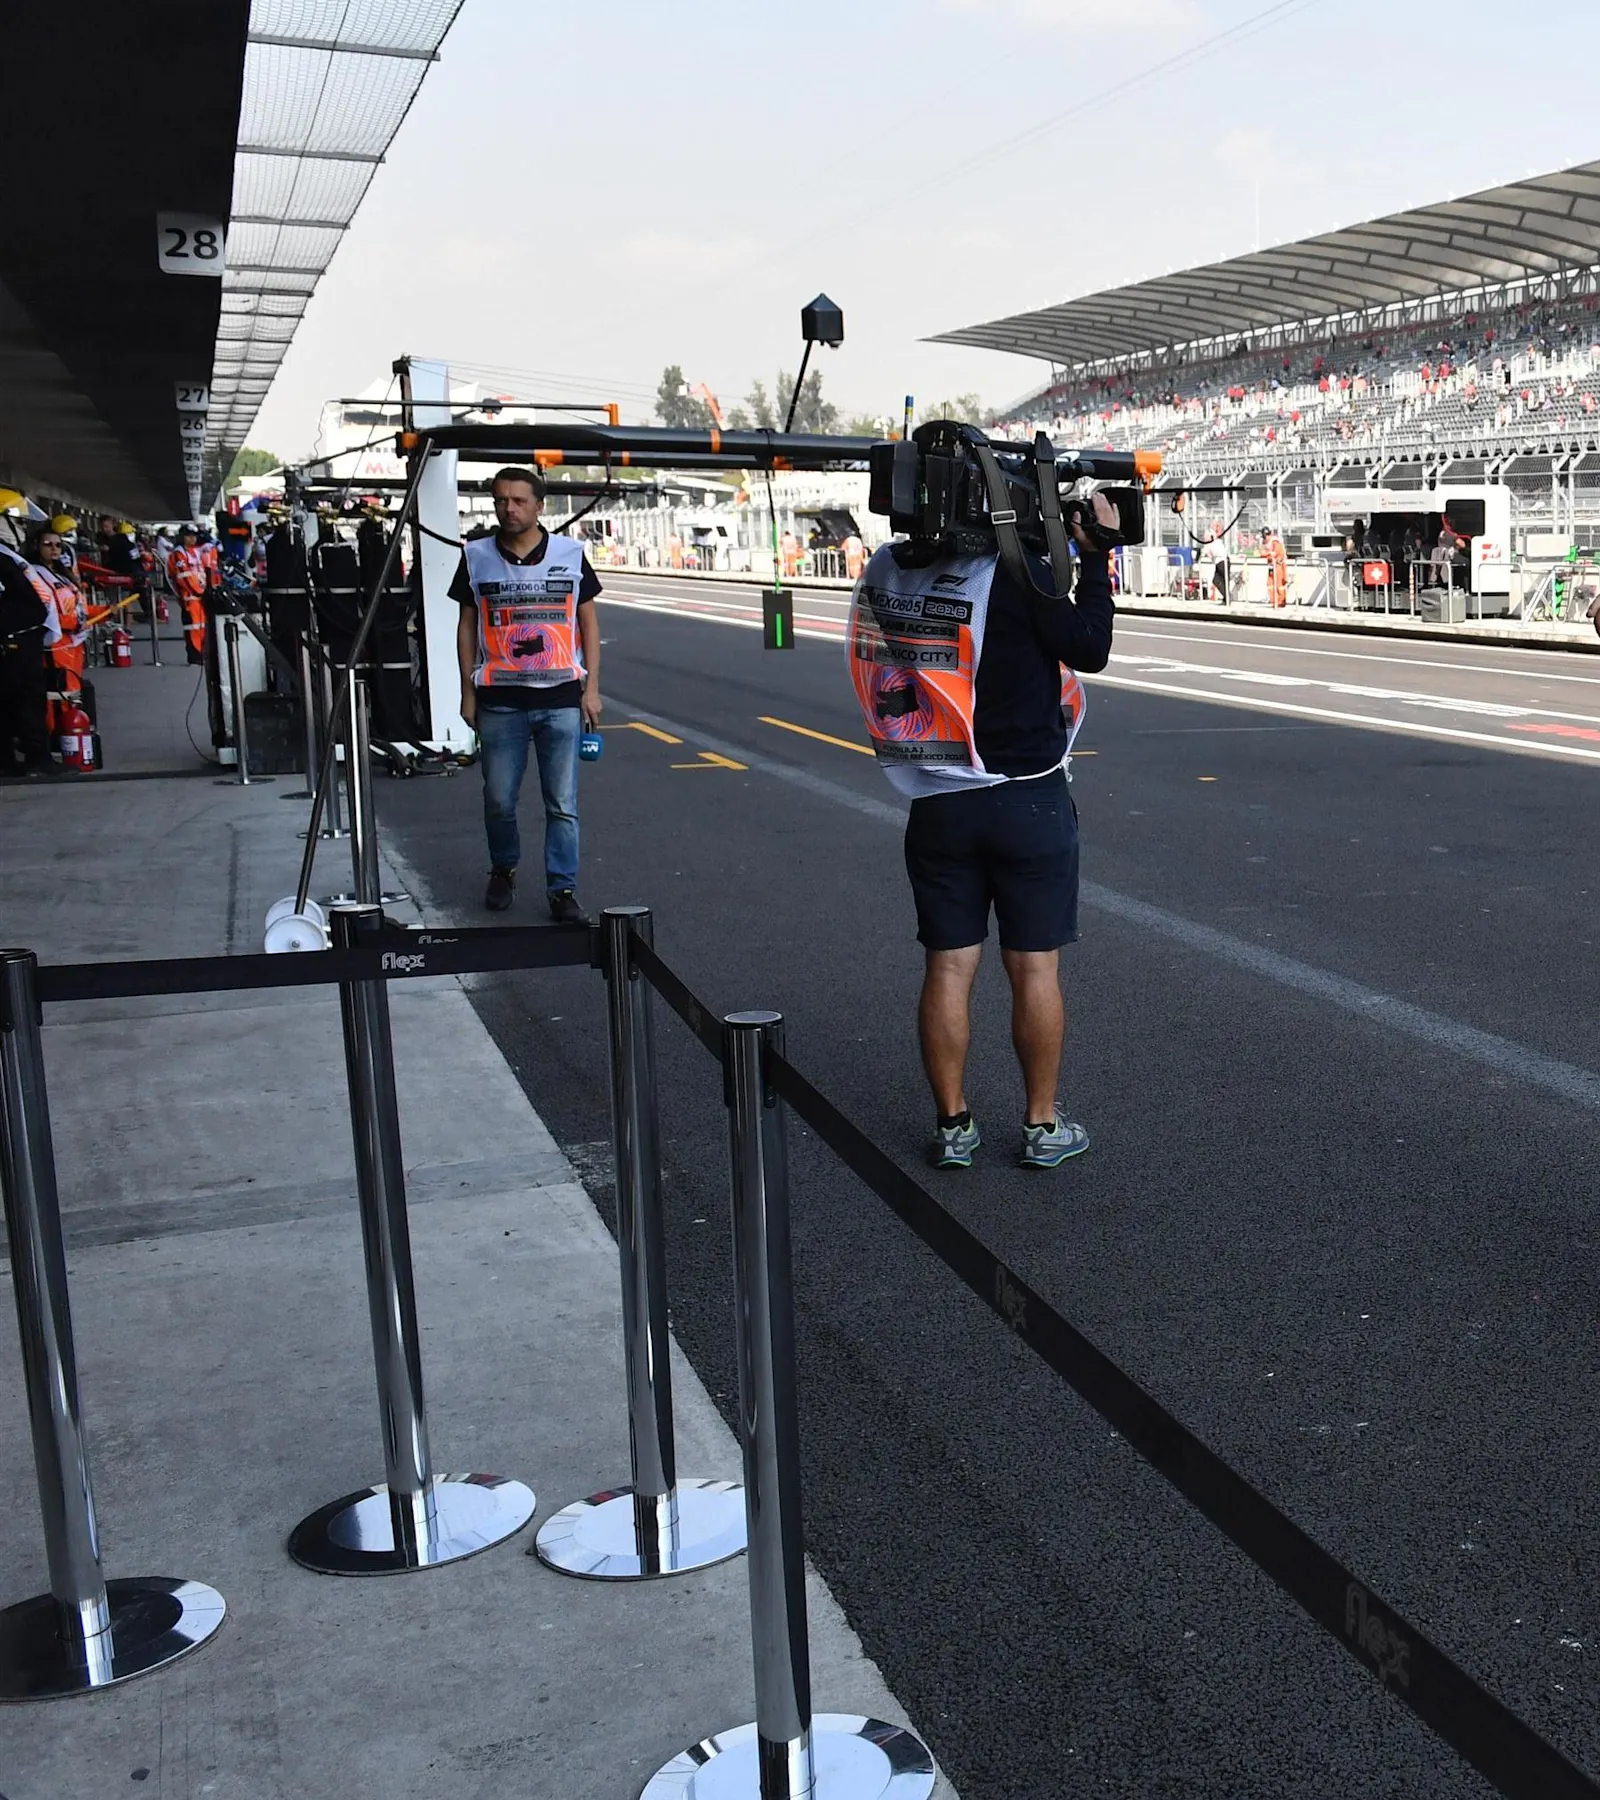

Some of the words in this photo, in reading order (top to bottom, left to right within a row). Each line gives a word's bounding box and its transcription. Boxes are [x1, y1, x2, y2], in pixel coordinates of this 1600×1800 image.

[165, 228, 219, 260] 28
[178, 387, 205, 403] 27
[183, 419, 203, 430] 26
[925, 601, 968, 619] 2018
[920, 651, 954, 663] CITY
[381, 951, 426, 973] flex
